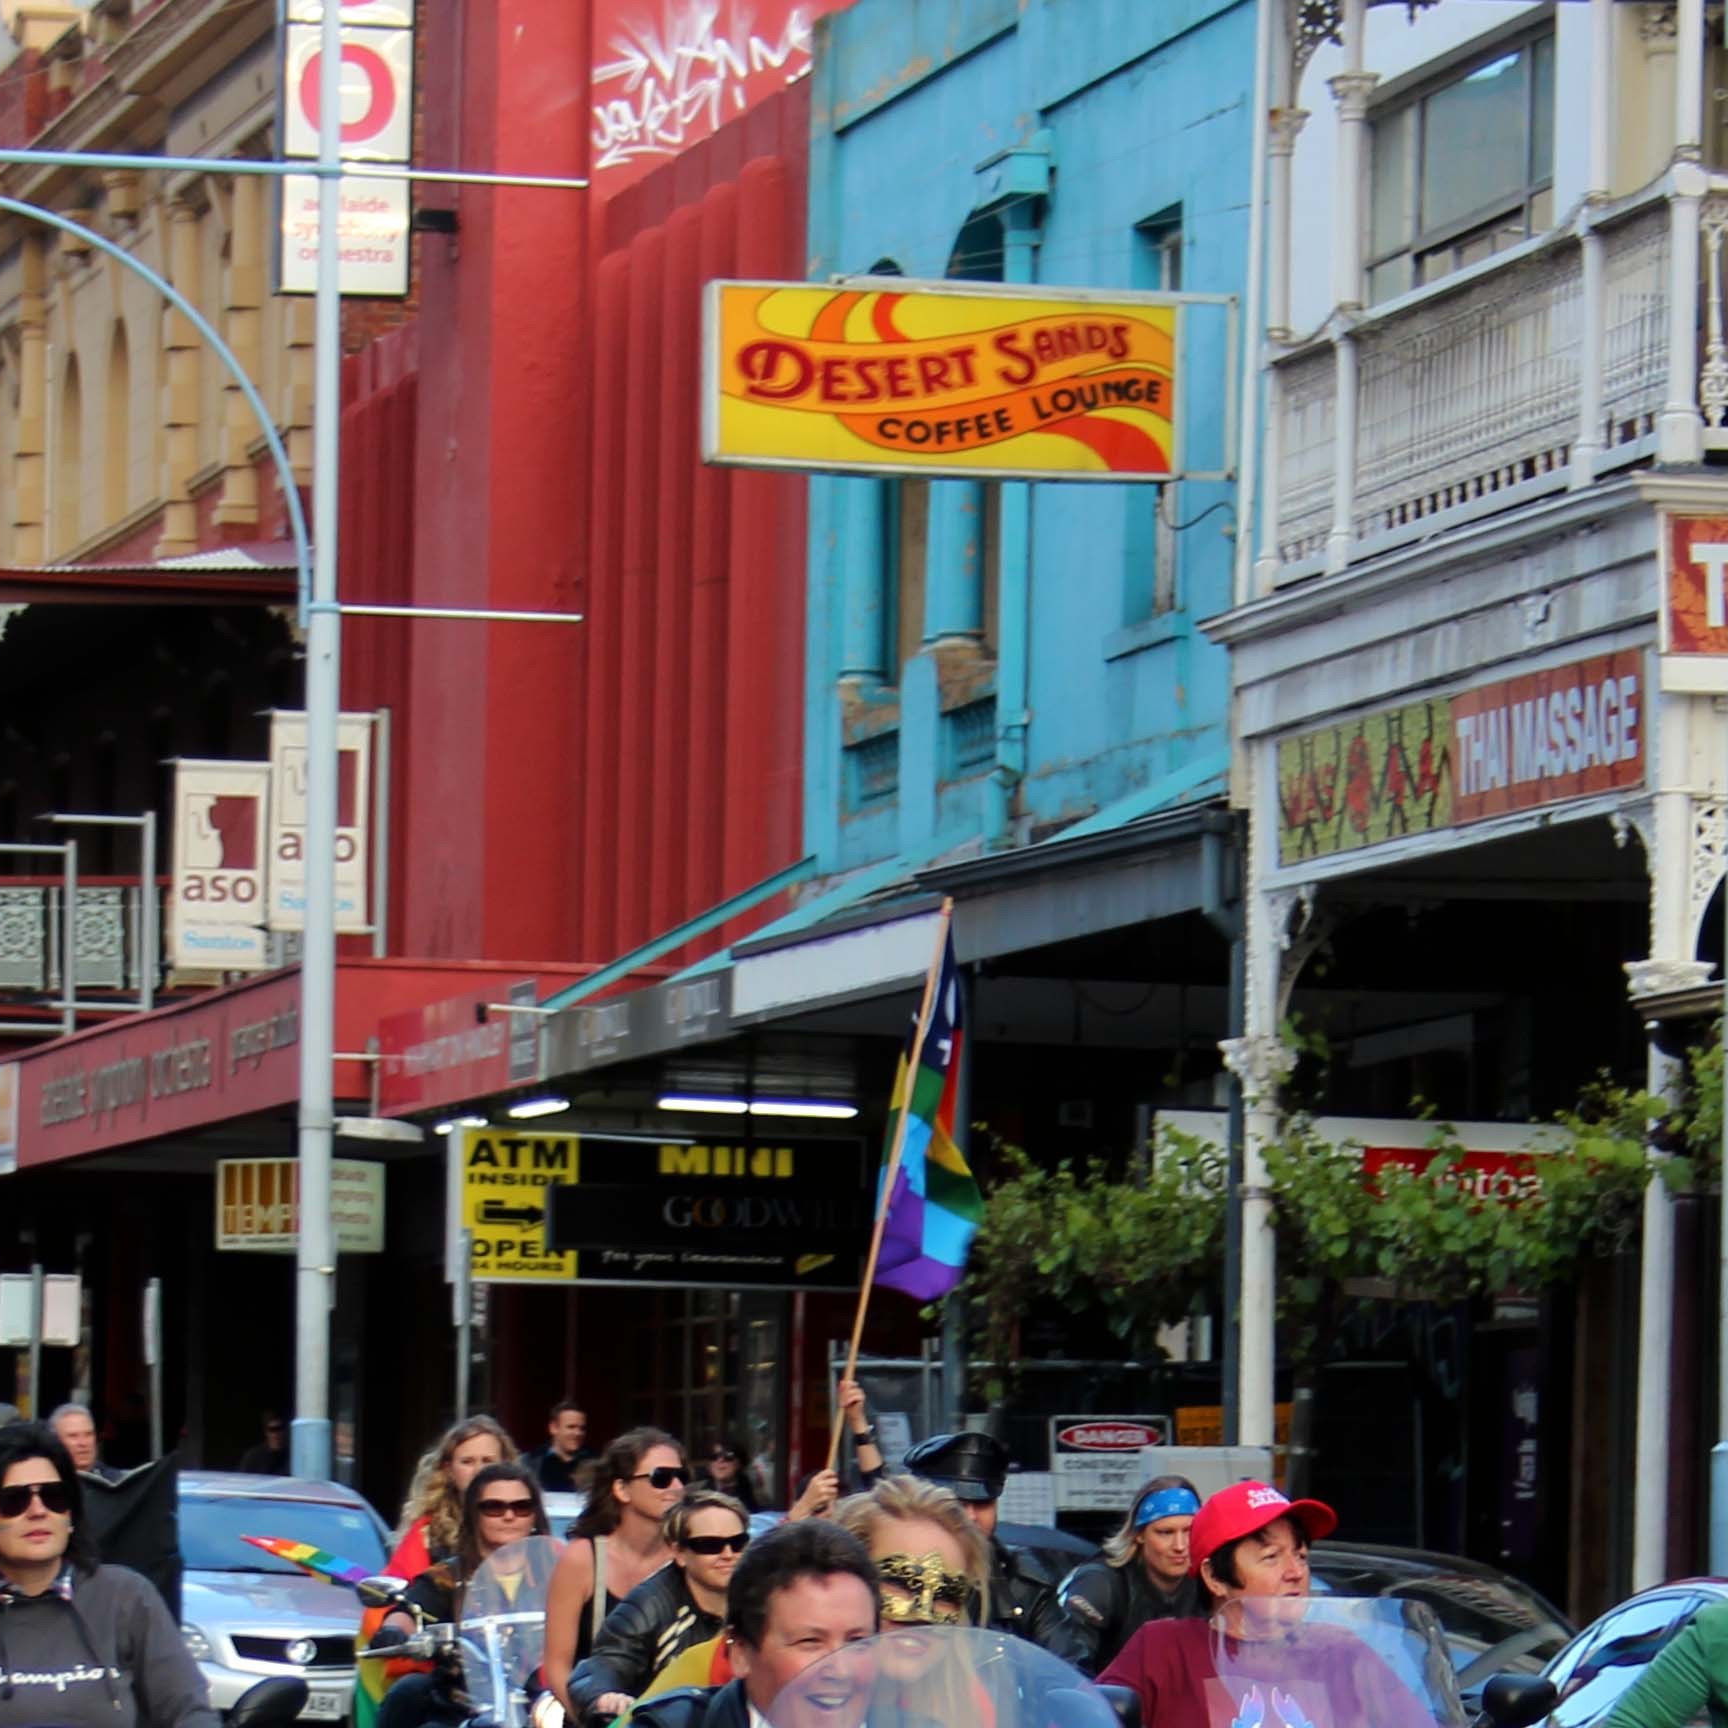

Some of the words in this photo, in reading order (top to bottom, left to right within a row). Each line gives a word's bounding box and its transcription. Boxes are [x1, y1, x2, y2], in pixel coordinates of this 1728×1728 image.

[736, 339, 978, 403] DESERT
[991, 321, 1134, 386] SANDS
[877, 408, 1014, 446] COFFEE
[1031, 377, 1162, 421] LOUNGE
[1456, 706, 1510, 797] THAI
[1512, 675, 1638, 784] MASSAGE
[277, 831, 357, 863] ao
[182, 874, 257, 903] aso
[470, 1139, 569, 1170] ATM
[468, 1173, 568, 1187] INSIDE
[471, 1238, 567, 1259] OPEN
[495, 1260, 565, 1273] HOURS
[1074, 1429, 1149, 1444] DANGER
[1063, 1459, 1140, 1470] CONSTRUCT
